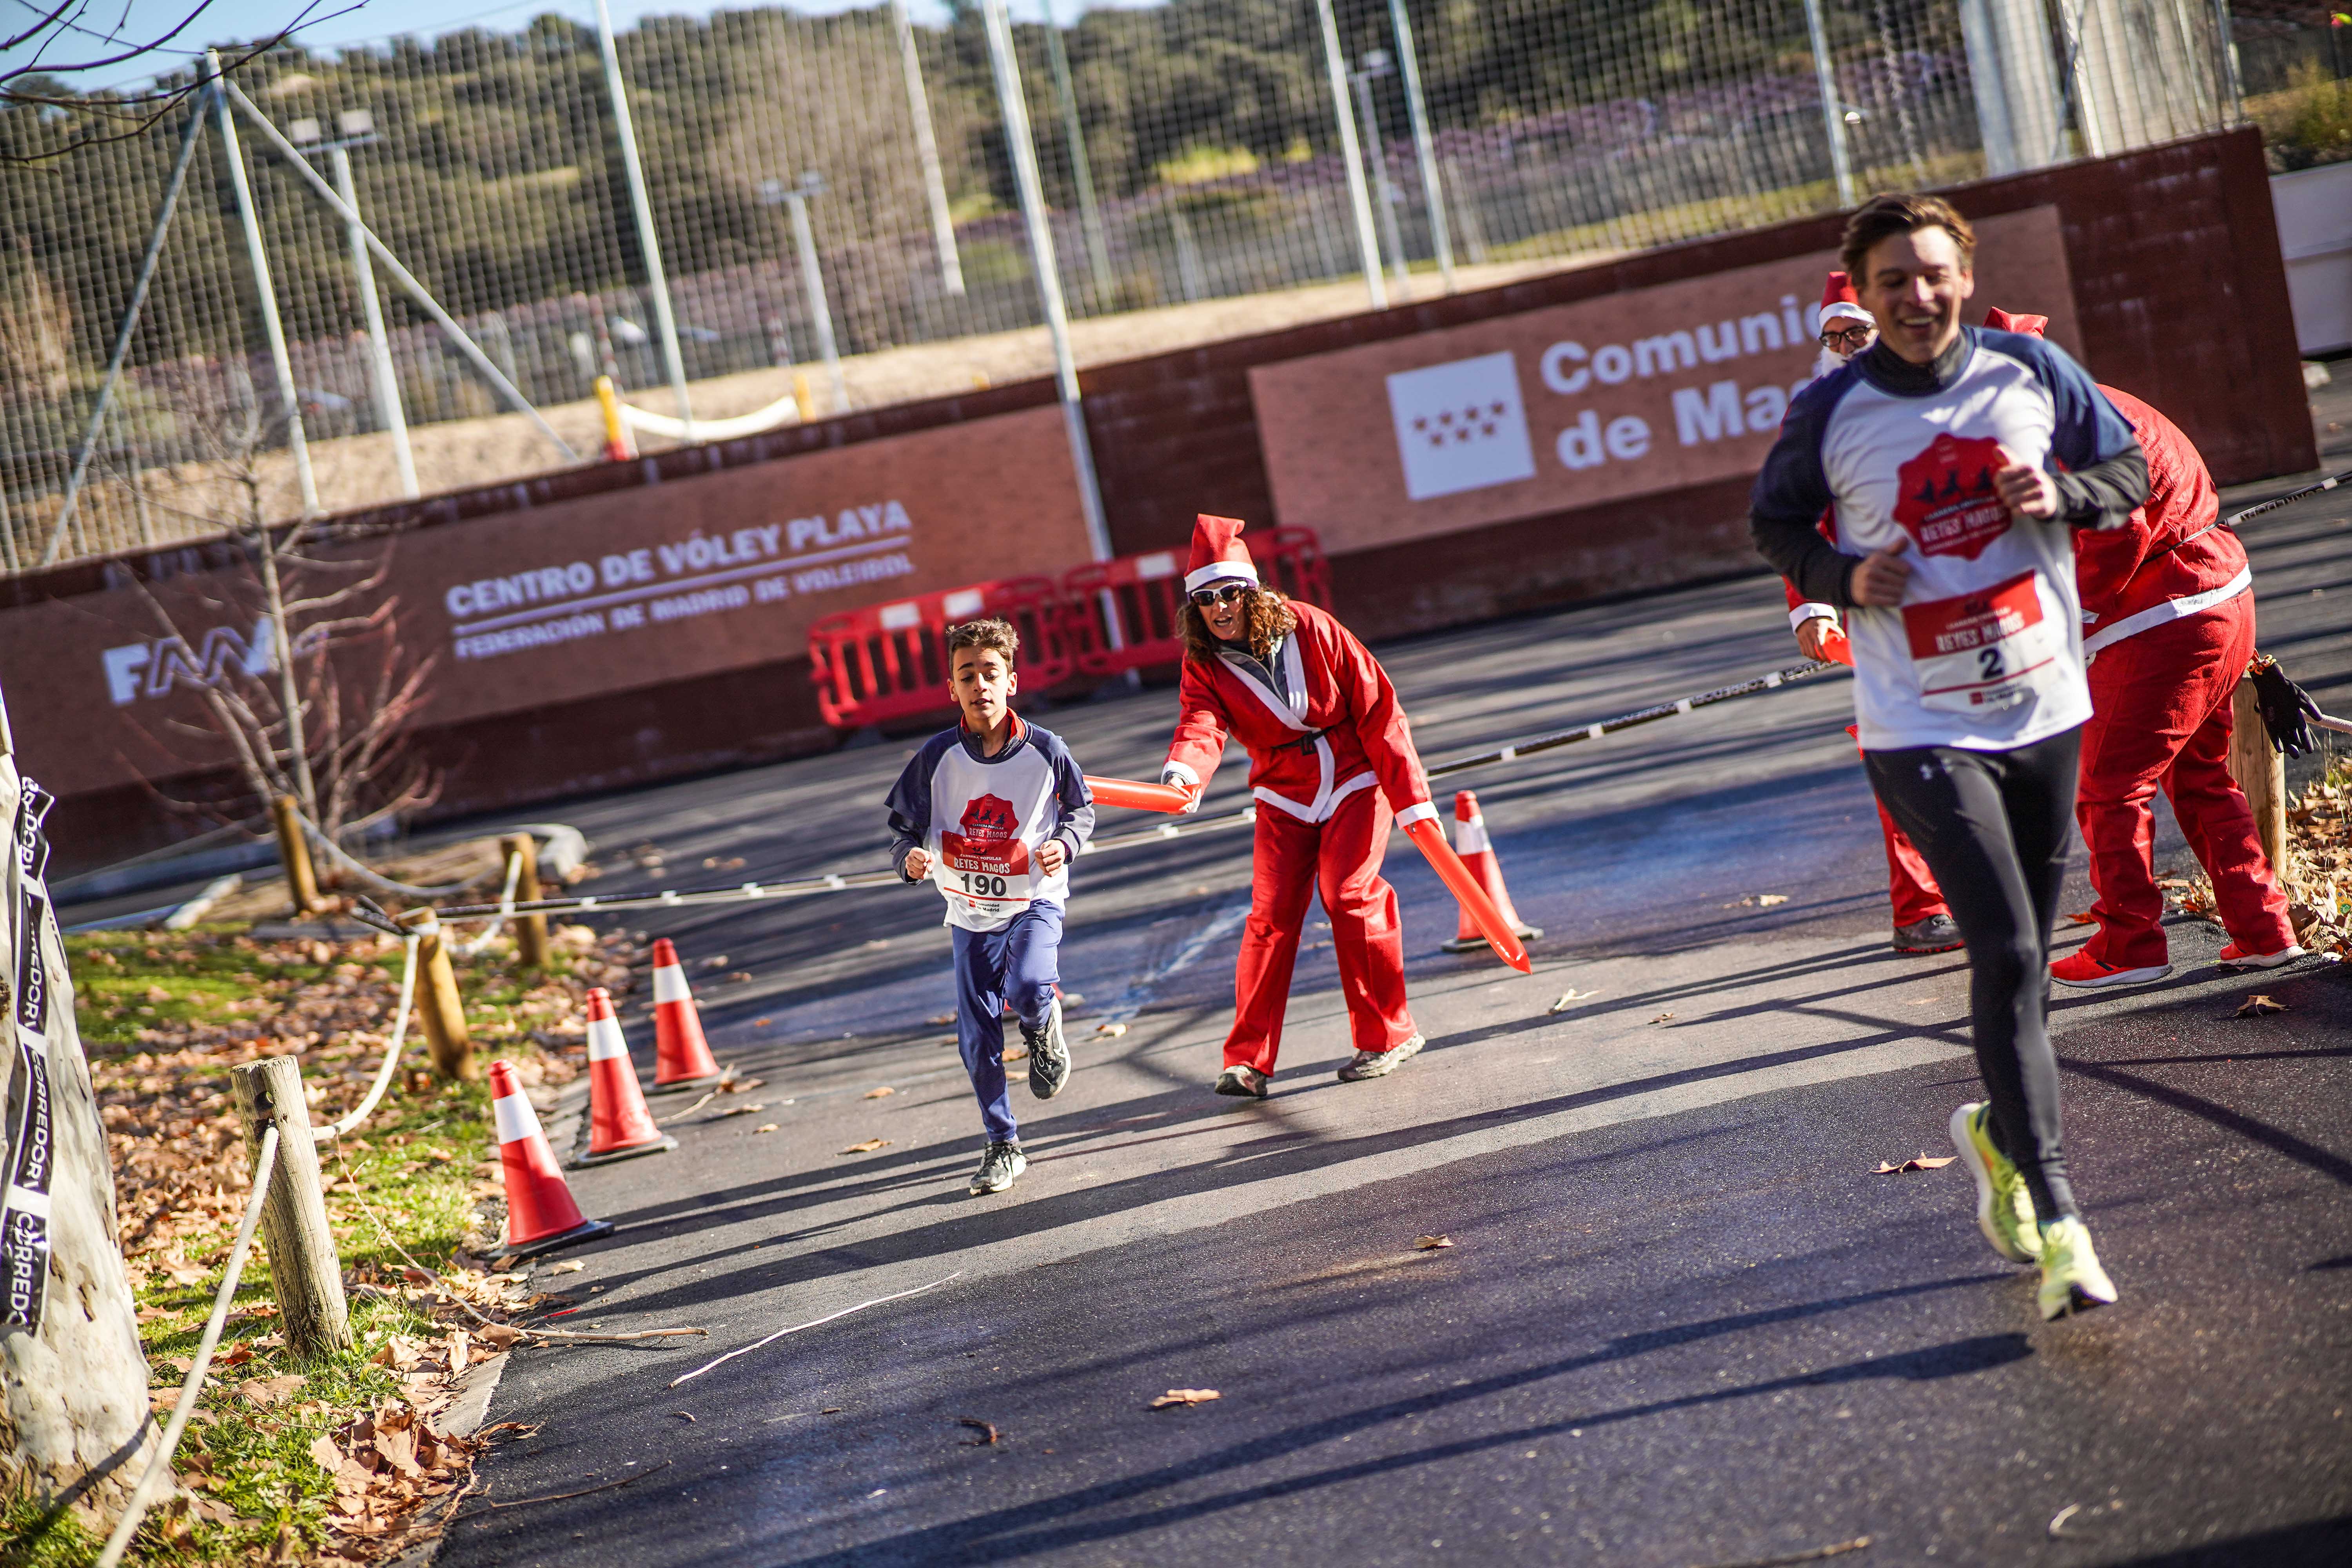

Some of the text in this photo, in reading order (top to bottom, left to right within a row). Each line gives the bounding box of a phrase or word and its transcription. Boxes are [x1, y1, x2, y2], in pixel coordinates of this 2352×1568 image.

[1556, 365, 1821, 472] de Ma
[1919, 517, 1961, 543] REYES
[446, 500, 912, 618] CENTRO DE VÓLEY PLAYA
[610, 603, 644, 630] DE
[650, 584, 750, 621] MADRID
[754, 576, 791, 603] DE
[1935, 628, 1979, 652] REYES
[1977, 648, 2005, 681] 2
[969, 828, 985, 837] REYES
[954, 857, 1010, 874] REYES MAGOS
[961, 873, 1007, 897] 190
